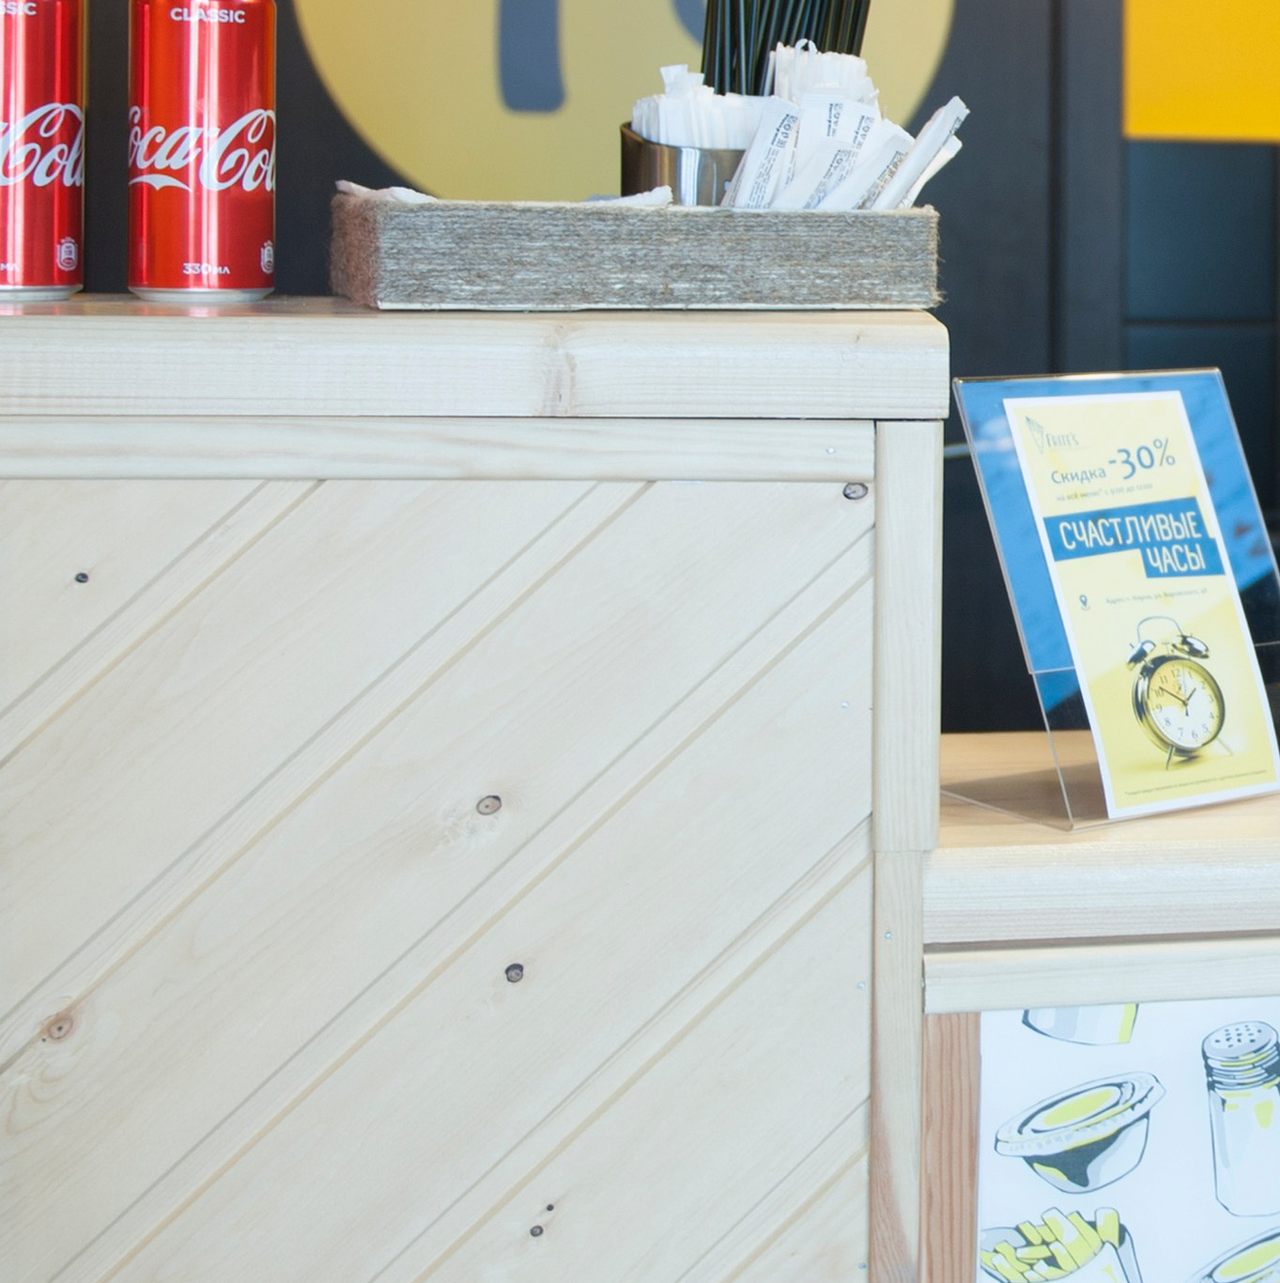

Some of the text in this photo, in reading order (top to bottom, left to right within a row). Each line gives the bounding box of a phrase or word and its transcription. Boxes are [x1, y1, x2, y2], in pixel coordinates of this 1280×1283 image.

[170, 7, 246, 23] CLASSIC
[1051, 437, 1176, 485] Скидка -30%
[1059, 511, 1202, 550] СЧАСТЛИВЫЕ
[1146, 543, 1206, 574] ЧАСЫ
